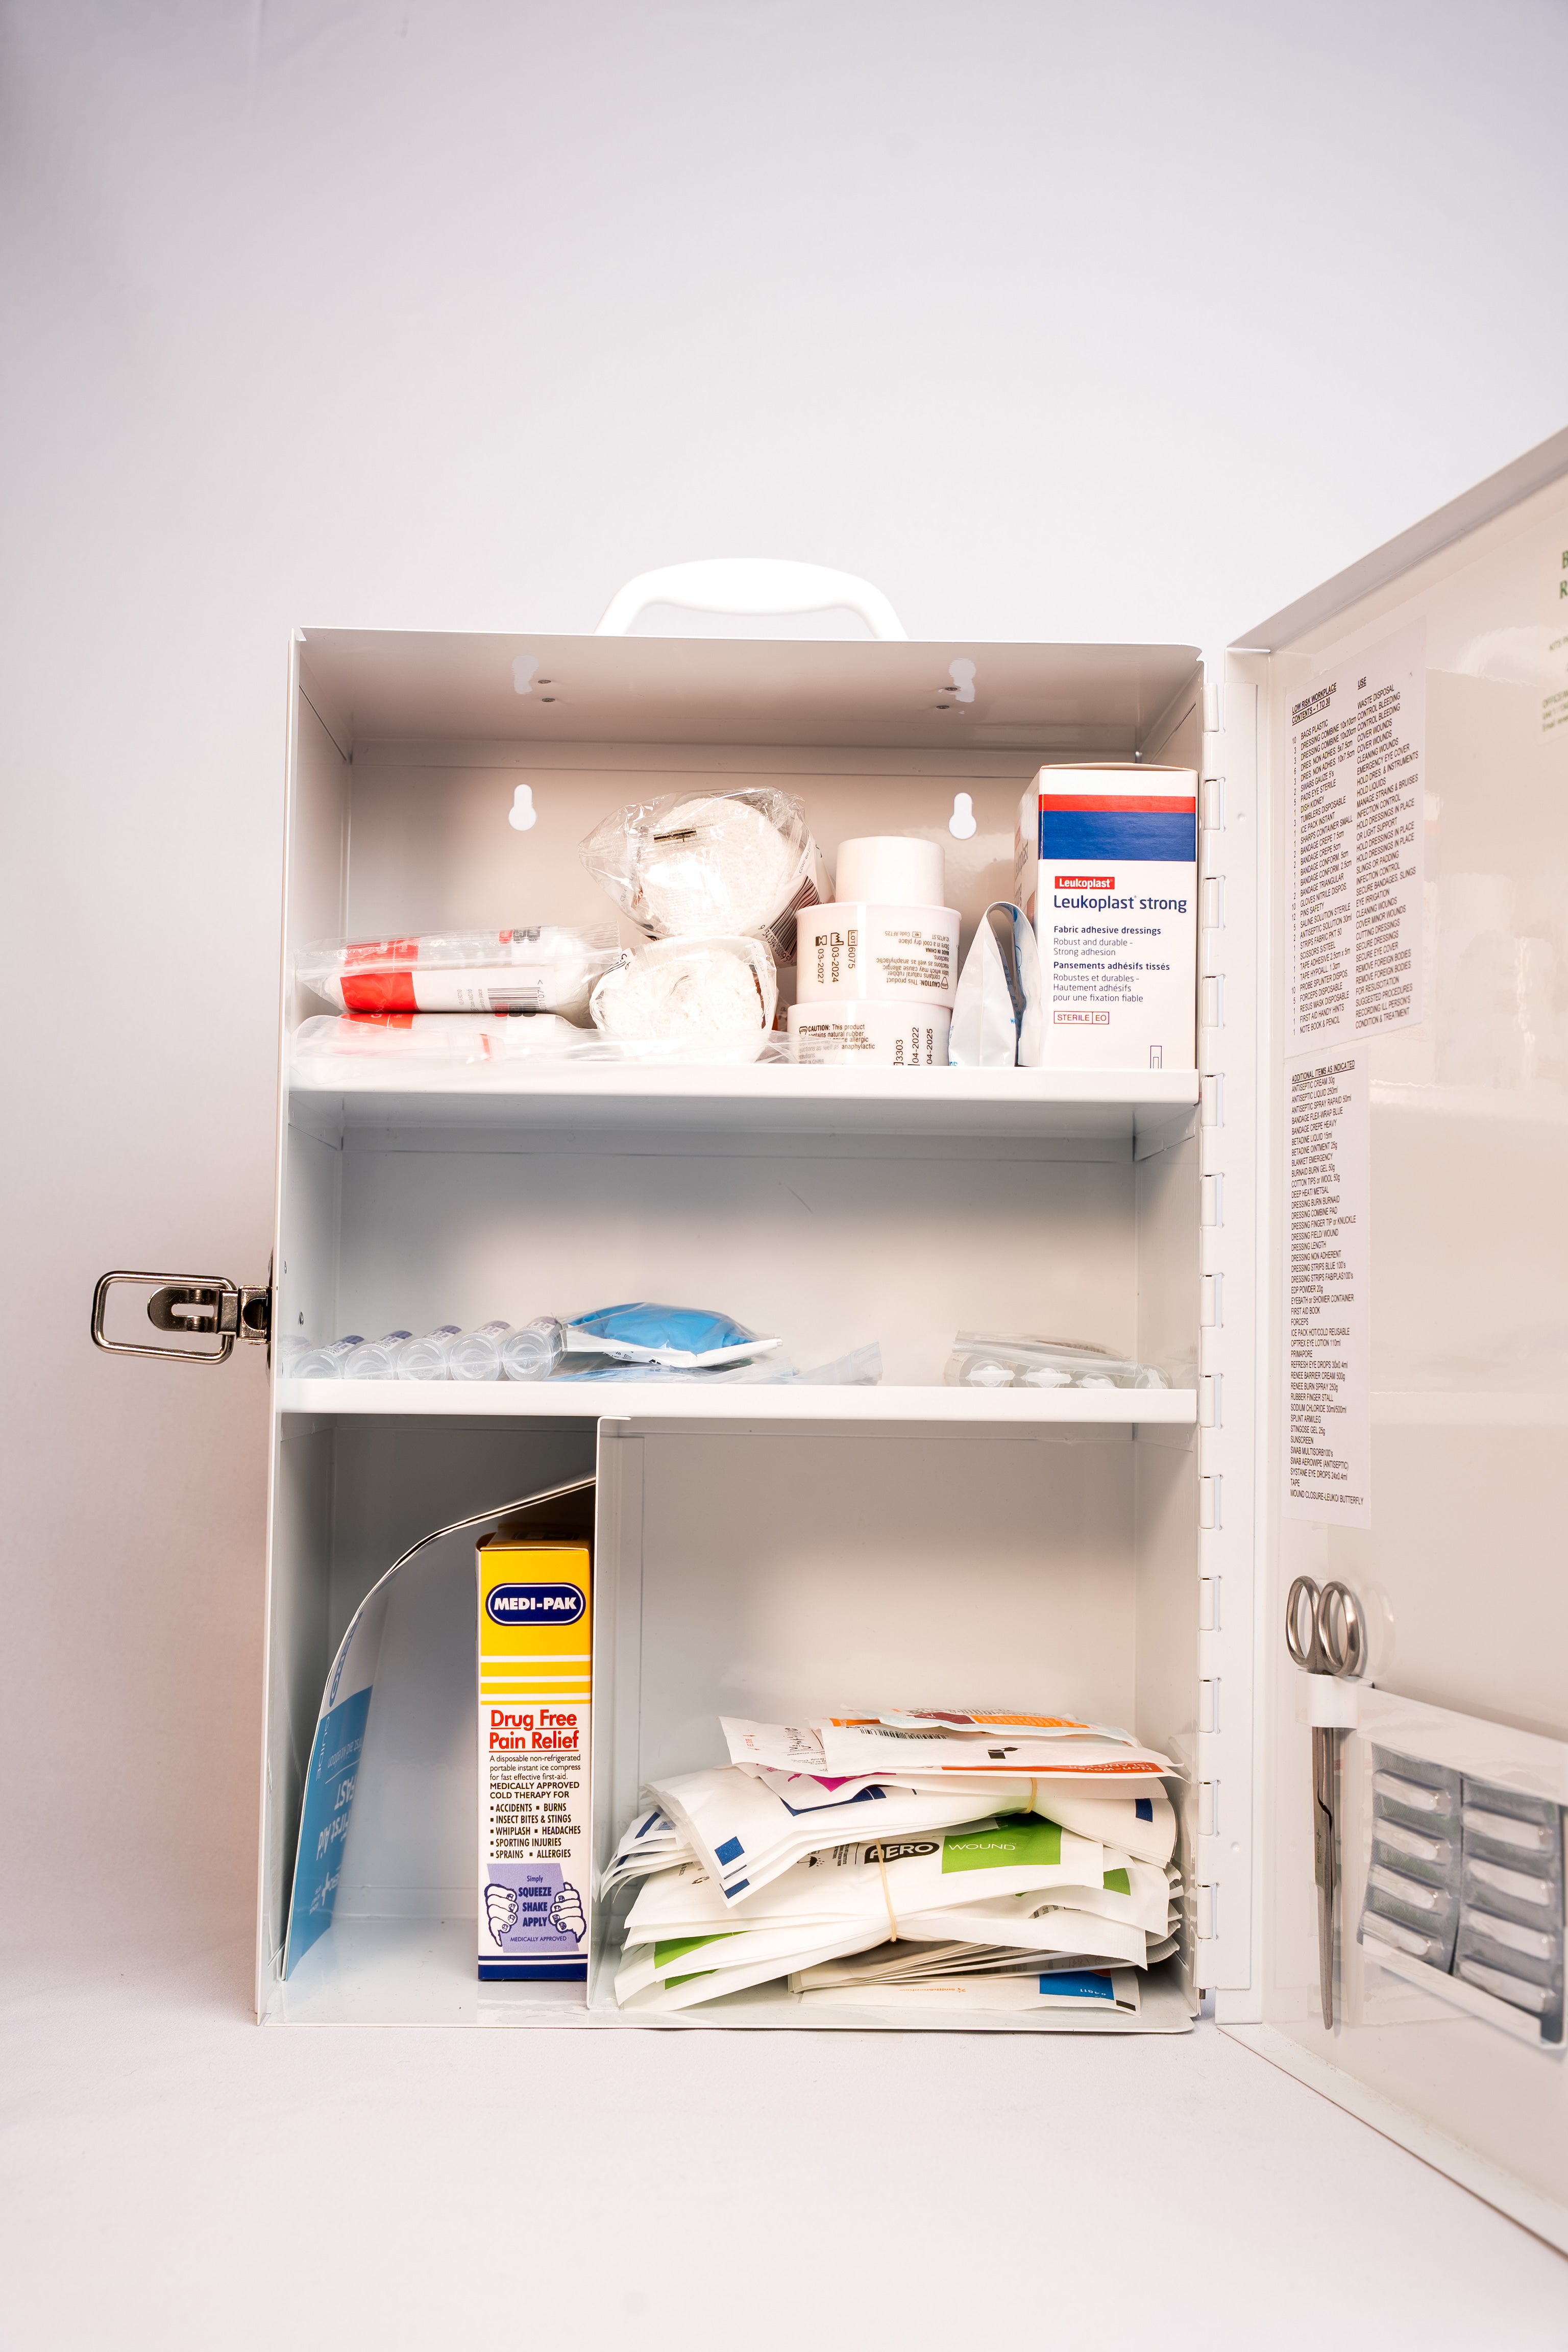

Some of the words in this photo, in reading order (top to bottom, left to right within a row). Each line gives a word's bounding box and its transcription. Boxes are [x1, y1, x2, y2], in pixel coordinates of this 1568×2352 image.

[1358, 677, 1366, 688] USE
[1292, 702, 1301, 714] LOW
[1302, 697, 1311, 708] RISK
[1311, 682, 1337, 704] WORKPLACE
[1357, 695, 1372, 709] WASTE
[1373, 684, 1394, 701] DISPOSAL
[1292, 709, 1313, 724] CONTENTS
[1319, 701, 1326, 710] TO
[1326, 698, 1331, 706] 30
[1357, 704, 1378, 721] CONTROL
[1378, 692, 1400, 709] BLEEDING
[1301, 728, 1311, 740] BAGS
[1312, 720, 1328, 733] PLASTIC
[1301, 733, 1320, 751] DRESSING
[1321, 724, 1339, 742] COMBINE
[1139, 897, 1187, 913] strong
[1121, 926, 1161, 936] dressings
[1099, 938, 1128, 946] durable
[1054, 947, 1079, 957] Strong
[1054, 961, 1105, 969] Pansements
[1054, 973, 1089, 982] Robustes
[1101, 974, 1134, 982] durables
[1300, 1013, 1311, 1023] FIRST
[1318, 1007, 1332, 1017] HANDY
[1332, 1003, 1344, 1013] HINTS
[1300, 1024, 1310, 1034] NOTE
[1311, 1020, 1322, 1031] BOOK
[1326, 1016, 1340, 1026] PENCIL
[1292, 1070, 1314, 1082] ADDITIONAL
[1314, 1067, 1326, 1076] ITEMS
[1327, 1066, 1333, 1074] AS
[1333, 1060, 1355, 1072] INDICATED
[1291, 1081, 1313, 1093] ANTISEPTIC
[1313, 1078, 1327, 1088] CREAM
[1291, 1092, 1313, 1104] ANTISEPTIC
[1314, 1089, 1326, 1098] LIQUID
[1327, 1087, 1337, 1095] 250ml
[1291, 1317, 1309, 1326] FORCEPS
[1290, 1425, 1310, 1433] STINGOSE
[1290, 1435, 1313, 1444] SUNSCREEN
[1290, 1479, 1300, 1487] TAPE
[494, 1597, 577, 1610] MEDI-PAK
[491, 1710, 533, 1730] Drug
[540, 1709, 577, 1726] Free
[489, 1731, 525, 1749] Pain
[532, 1730, 578, 1749] Relief
[315, 1716, 330, 1781] GUIDE
[496, 1755, 528, 1763] disposable
[530, 1754, 580, 1763] non-refrigerated
[490, 1764, 516, 1773] portable
[496, 1803, 532, 1812] ACCIDENTS
[544, 1803, 566, 1811] BURNS
[496, 1815, 519, 1824] INSECT
[521, 1815, 538, 1824] BITES
[540, 1815, 545, 1823] &
[547, 1814, 571, 1823] STINGS
[496, 1827, 530, 1835] WHIPLASH
[542, 1826, 580, 1834] HEADACHES
[316, 1823, 331, 1861] Aid
[496, 1838, 530, 1847] SPORTING
[532, 1837, 561, 1847] INJURIES
[496, 1850, 523, 1858] SPRAINS
[537, 1849, 571, 1858] ALLERGIES
[870, 1845, 933, 1859] AERO
[527, 1875, 543, 1883] Simply
[518, 1886, 552, 1897] SQUEEZE
[522, 1902, 548, 1912] SHAKE
[522, 1917, 548, 1927] APPLY
